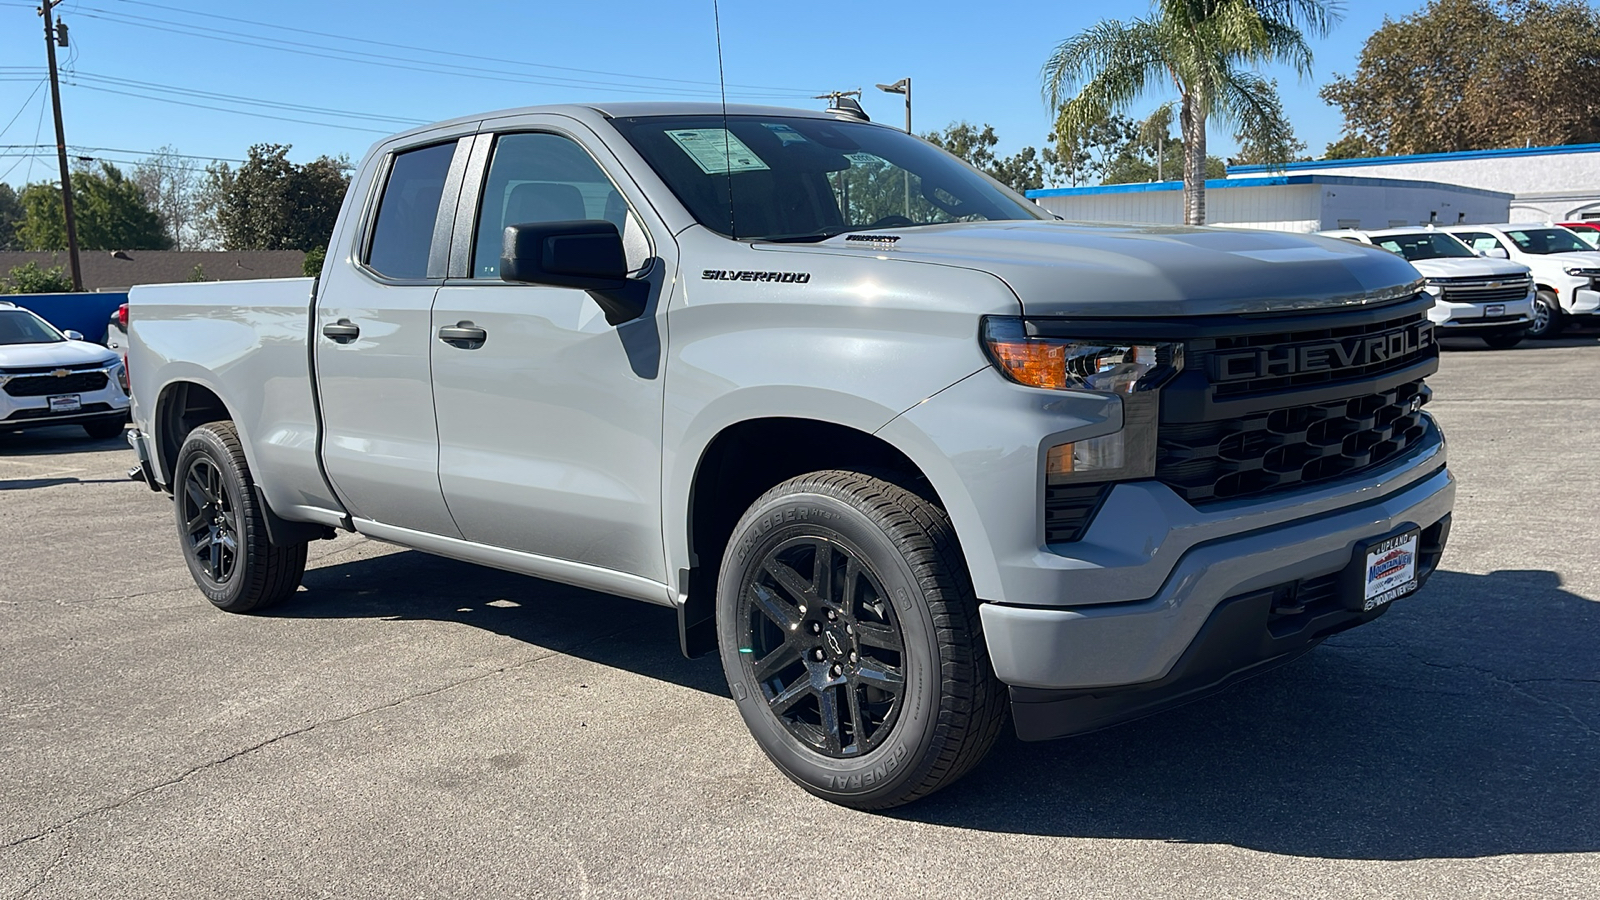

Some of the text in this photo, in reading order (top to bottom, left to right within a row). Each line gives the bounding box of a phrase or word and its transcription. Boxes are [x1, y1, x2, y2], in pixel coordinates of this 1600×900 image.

[702, 270, 811, 284] SILVERADO
[1220, 321, 1436, 380] CHEVROLET
[737, 506, 810, 566] GRABBER
[1381, 534, 1408, 551] UPLAND
[1368, 557, 1398, 584] MOUNTAIN
[1399, 552, 1412, 566] VIEW
[823, 741, 908, 789] GENERAL
